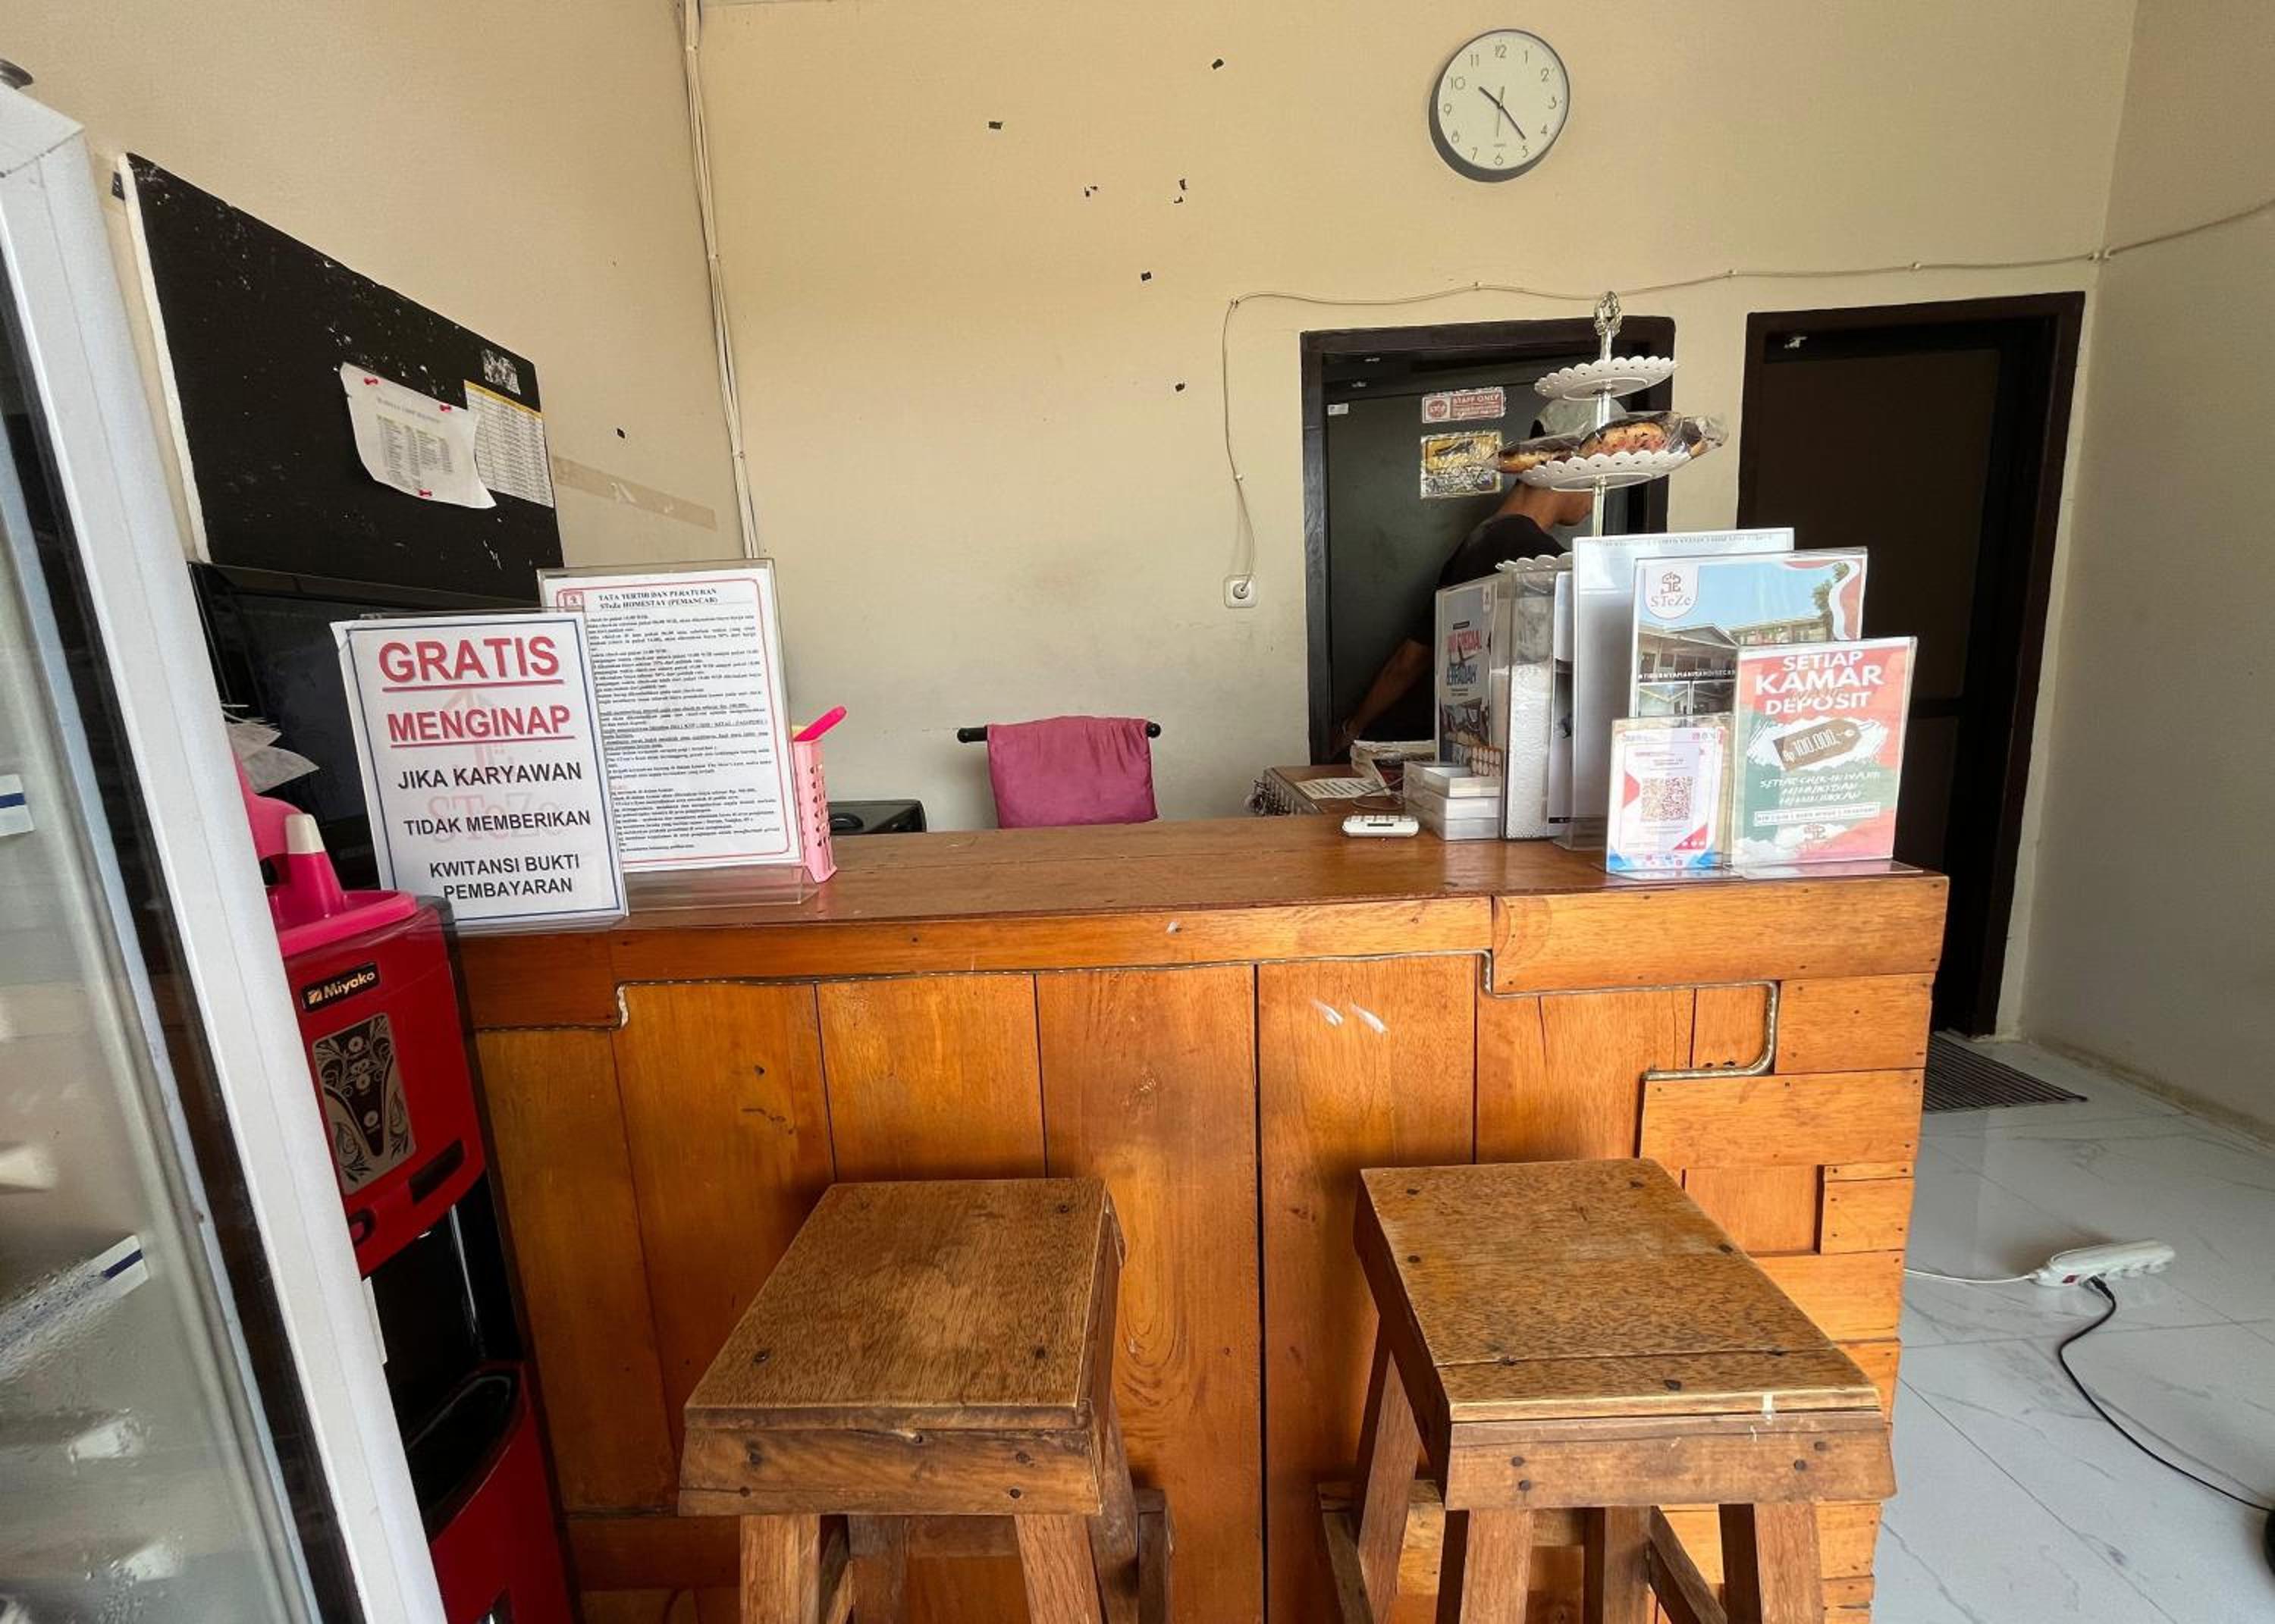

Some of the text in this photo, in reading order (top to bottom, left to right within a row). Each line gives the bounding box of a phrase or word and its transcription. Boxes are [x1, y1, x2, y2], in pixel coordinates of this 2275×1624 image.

[1495, 44, 1508, 58] 12
[1470, 54, 1480, 67] 11
[1540, 67, 1550, 82] 2
[1451, 76, 1466, 90] 10
[1443, 103, 1452, 117] 9
[1549, 96, 1557, 110] 3
[1451, 130, 1460, 143] 8
[1540, 124, 1548, 135] 4
[1471, 146, 1478, 161] 7
[1521, 145, 1529, 158] 5
[1493, 153, 1504, 166] 6
[379, 635, 560, 683] GRATIS
[1783, 651, 1864, 672] SETIAP
[1755, 665, 1886, 695] KAMAR
[1765, 691, 1872, 716] DEPOSIT
[388, 704, 571, 742] MENGINAP
[398, 762, 582, 789] JIKA KARYAWAN
[403, 810, 592, 836] TIDAK MEMBERIKAN
[429, 854, 580, 878] KWITANSI BUKTI
[443, 877, 573, 901] PEMBAYARAN
[322, 970, 376, 1000] Miyako
